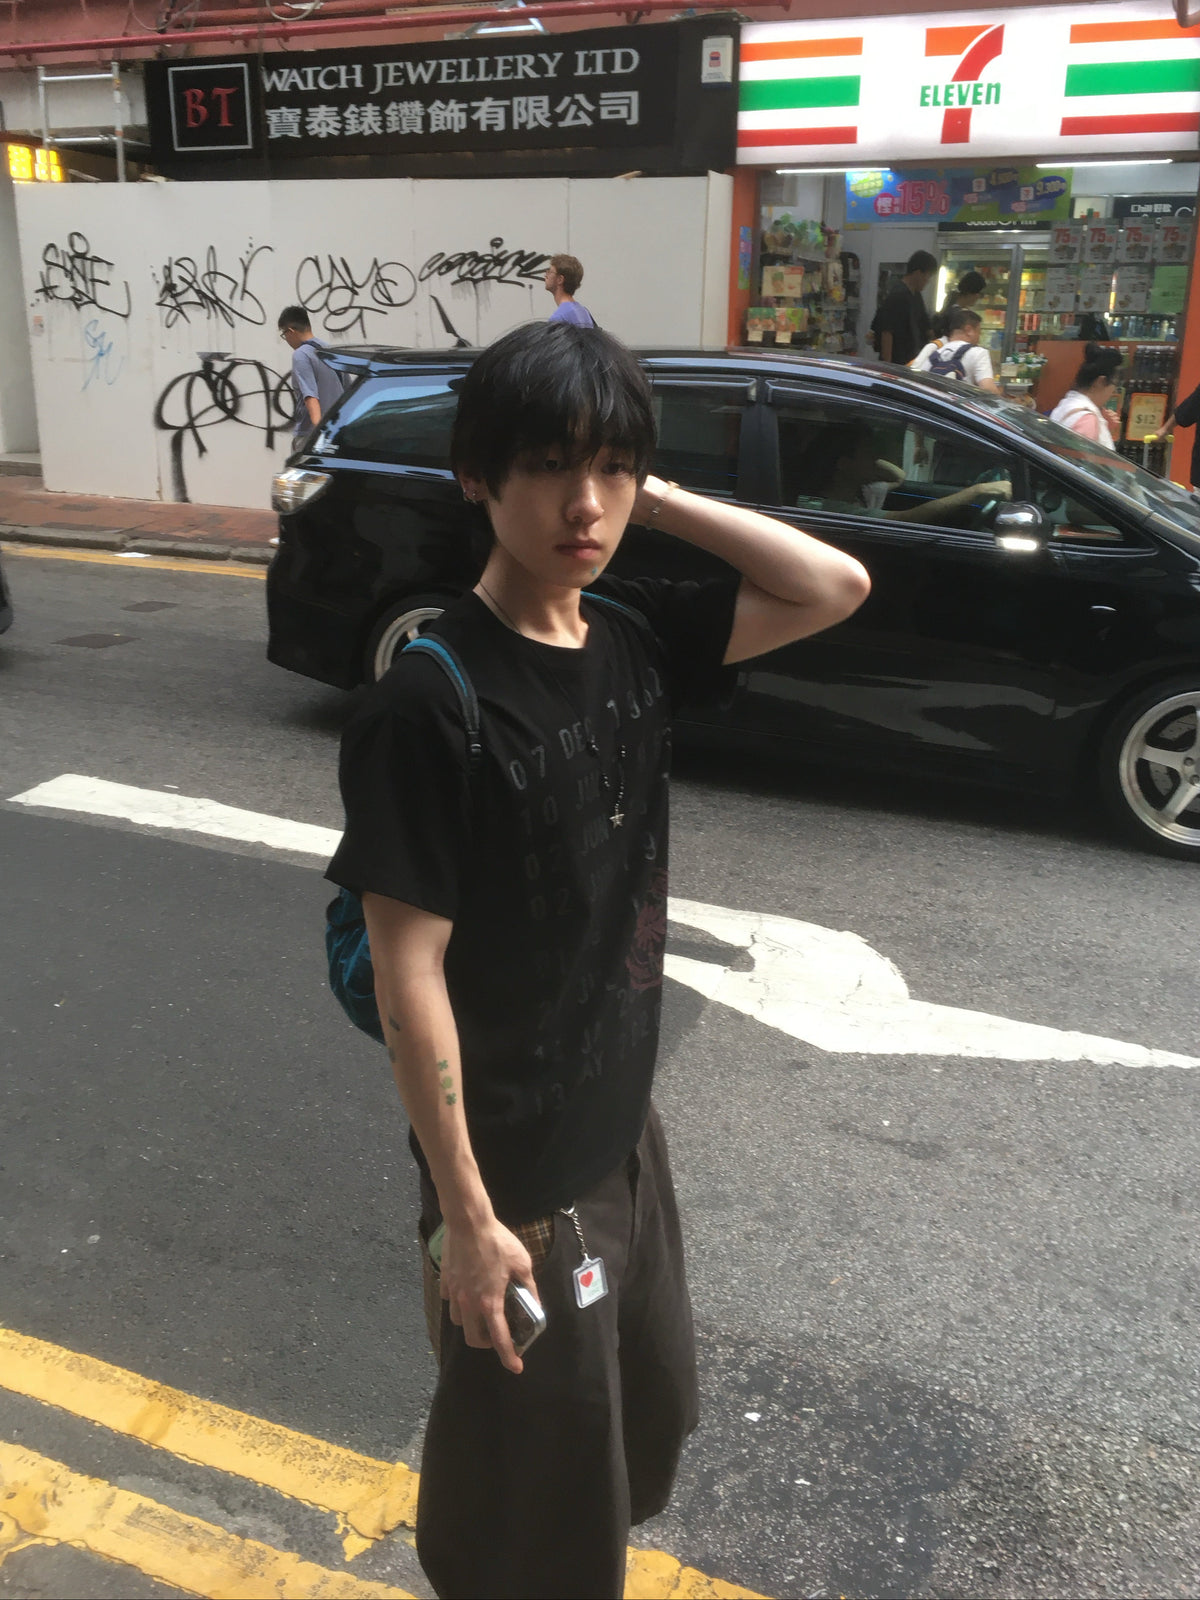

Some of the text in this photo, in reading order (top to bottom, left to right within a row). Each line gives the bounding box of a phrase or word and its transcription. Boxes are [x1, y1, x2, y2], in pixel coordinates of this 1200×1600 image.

[262, 48, 640, 95] WATCH JEWELLERY LTD
[925, 24, 1004, 144] 7
[183, 87, 239, 128] BT
[265, 90, 640, 139] 寶泰錶鑽飾有限公司
[896, 180, 951, 215] 15%
